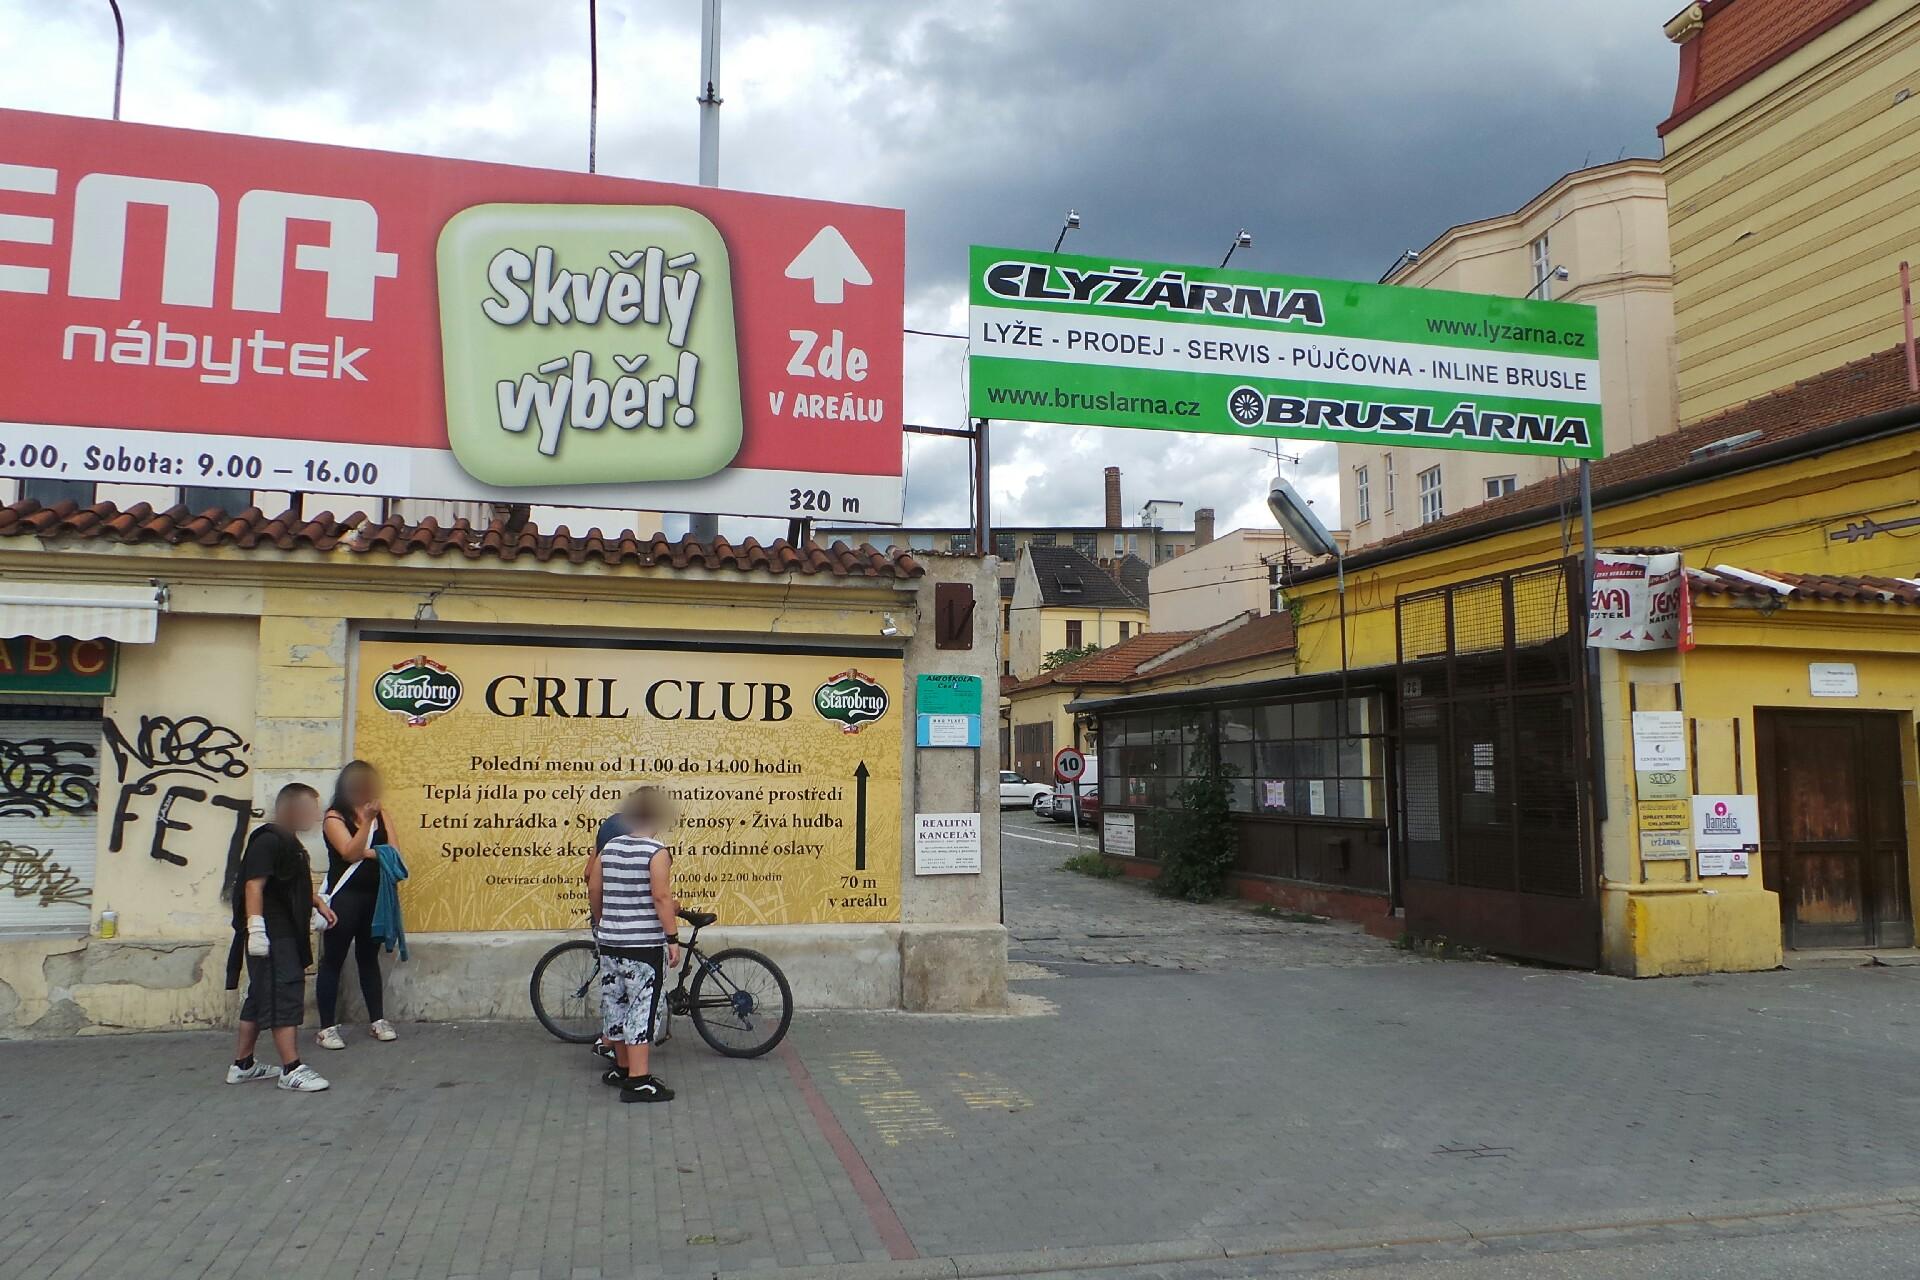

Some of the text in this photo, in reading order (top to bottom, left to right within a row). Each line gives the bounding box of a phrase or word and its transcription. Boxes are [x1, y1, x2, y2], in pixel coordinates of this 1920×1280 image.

[482, 246, 701, 348] Skvělý
[1426, 318, 1586, 348] www.lyzarna.cz
[62, 319, 371, 384] nábytek
[785, 329, 869, 382] Zde
[983, 320, 1043, 347] LYŽE
[1067, 330, 1165, 357] PRODEJ
[1188, 339, 1270, 364] SERVIS
[1292, 344, 1413, 377] PŮJČOVNA
[1432, 360, 1498, 384] INLINE
[1506, 367, 1587, 391] BRUSLE
[496, 350, 700, 456] výběr!
[769, 391, 884, 423] V AREÁLU
[987, 386, 1201, 417] www.bruslarna.cz
[1264, 394, 1592, 448] BRUSLÁRNA
[84, 445, 184, 476] Sobota:
[198, 453, 263, 479] 9.00
[303, 459, 379, 486] 16.00
[788, 488, 860, 513] 320 m
[381, 674, 457, 709] Starobrno
[485, 674, 794, 722] GRIL CLUB
[820, 686, 884, 718] Starobrno
[471, 756, 802, 774] Polední menu od 11.00 do 14.00 hodin
[1060, 757, 1079, 771] 10
[422, 783, 843, 805] Teplá jídla po celý den matizované prostředí
[420, 812, 468, 829] Letní
[473, 812, 557, 829] zahrádka
[668, 810, 843, 833] řenosy Živá hudba
[922, 817, 972, 828] REALITNÍ
[919, 829, 977, 840] KANCELÁŘ
[441, 841, 552, 863] Společenské
[687, 844, 697, 856] a
[702, 840, 769, 856] rodinné
[773, 840, 824, 859] oslavy
[485, 874, 540, 886] Otevírací
[542, 874, 574, 885] doba:
[673, 873, 701, 883] 10.00
[704, 873, 718, 883] do
[720, 872, 749, 882] 22.00
[752, 871, 782, 882] hodin
[840, 875, 877, 889] 70 m
[556, 889, 590, 900] sobot
[828, 893, 888, 908] v areálu
